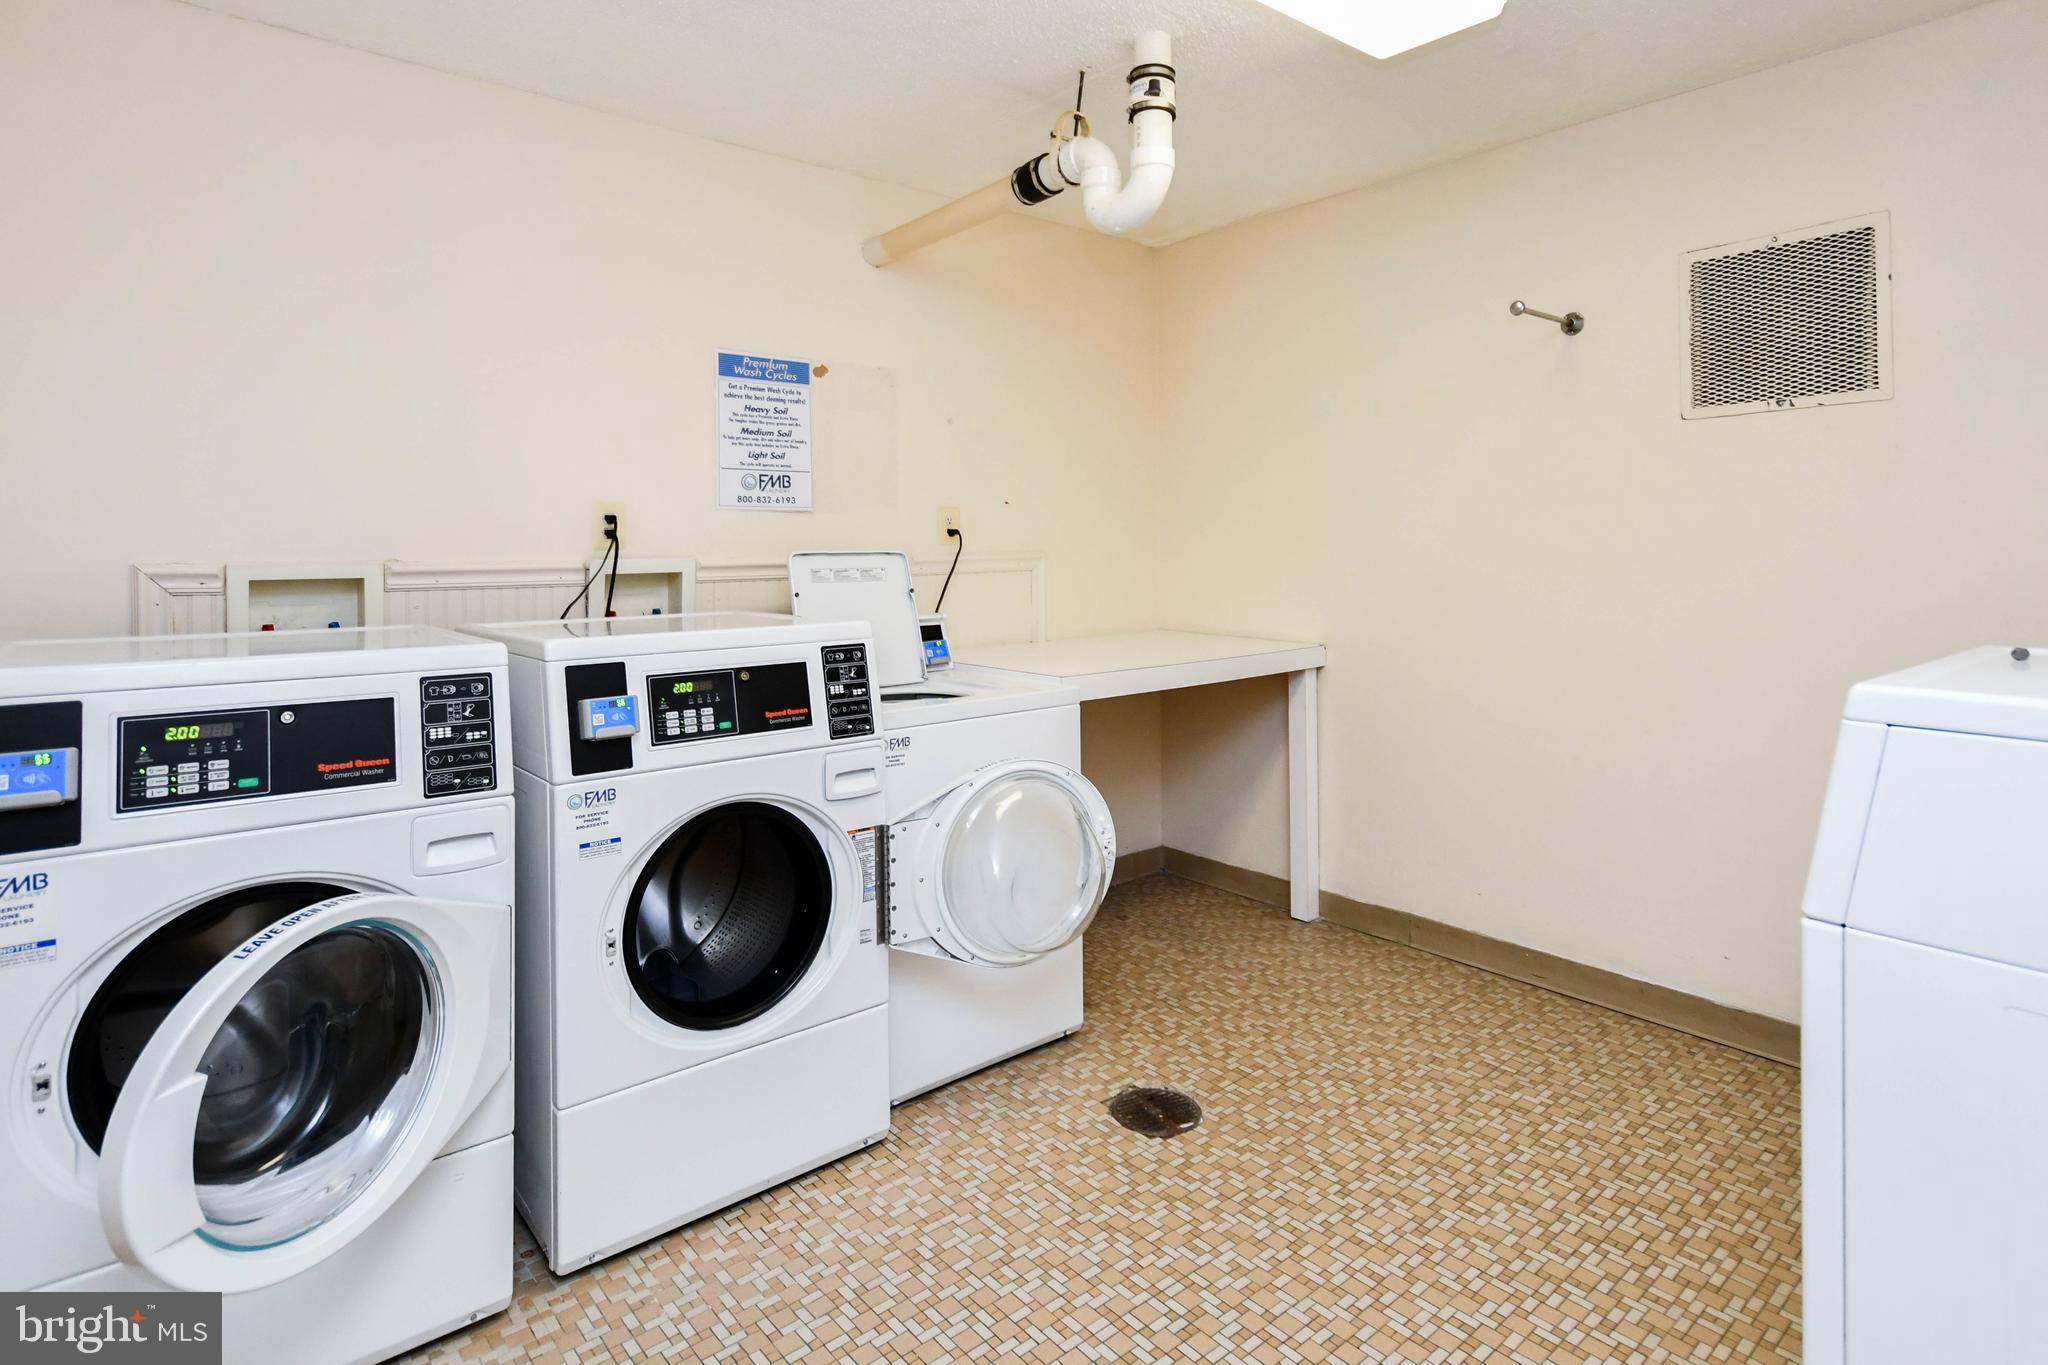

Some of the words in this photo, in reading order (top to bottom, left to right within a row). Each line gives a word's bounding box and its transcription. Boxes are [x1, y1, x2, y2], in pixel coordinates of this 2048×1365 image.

[743, 357, 788, 370] Premium
[734, 365, 761, 377] Wash
[765, 369, 797, 381] Cycles
[724, 392, 743, 400] achieve
[782, 388, 794, 396] Cycle
[744, 404, 770, 415] Heavy
[773, 407, 788, 415] Soil
[740, 427, 774, 436] Medium
[777, 429, 792, 438] Soil
[748, 450, 768, 461] Light
[770, 452, 786, 460] Soil
[759, 474, 791, 491] FMB
[737, 495, 796, 504] 800-832-6193
[165, 726, 200, 741] 2.00
[890, 736, 910, 751] FMB
[318, 760, 353, 772] Speed
[354, 758, 390, 768] Queen
[324, 771, 361, 780] Commercial
[362, 768, 384, 776] Washer
[584, 788, 617, 808] FMB
[587, 810, 609, 818] SERVICE
[0, 903, 34, 913] ERVICE
[233, 927, 283, 960] LEAVE
[281, 907, 323, 928] OPEN
